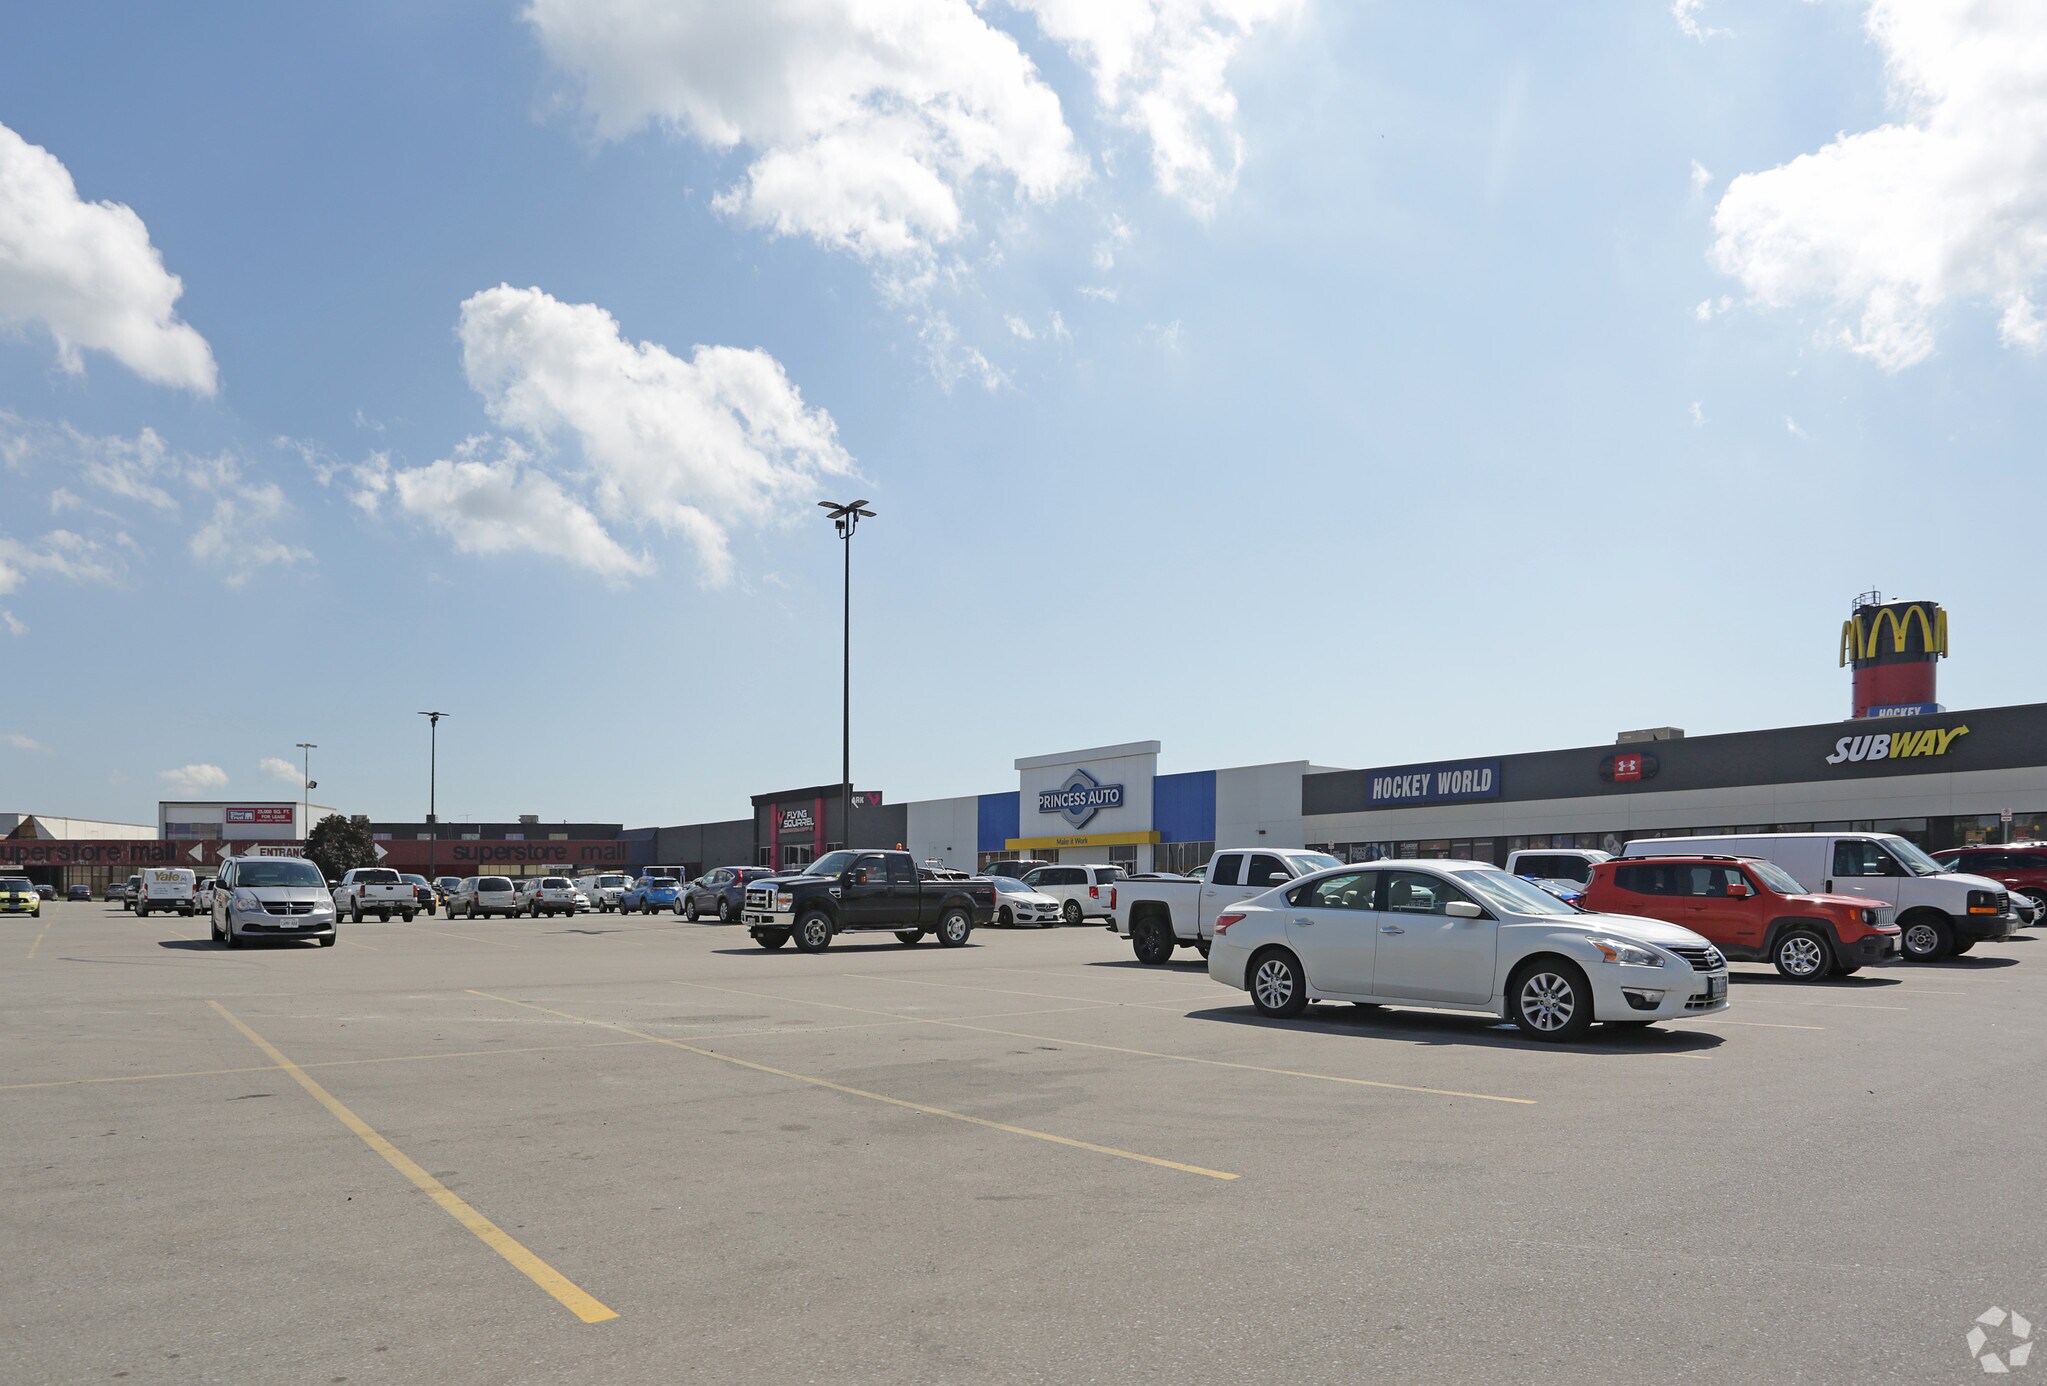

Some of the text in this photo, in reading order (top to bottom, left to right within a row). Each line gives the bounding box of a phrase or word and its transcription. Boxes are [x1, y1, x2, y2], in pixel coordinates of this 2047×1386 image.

[1879, 706, 1922, 717] HOCKEY
[1825, 724, 1970, 765] SUBWAY
[1373, 768, 1492, 799] HOCKEY WORLD
[1039, 789, 1119, 808] PRINCESS AUTO
[787, 809, 808, 819] FLYING
[783, 818, 814, 828] SQUIRREL
[0, 842, 176, 864] uperstore mall
[260, 847, 306, 857] ENTRANC
[453, 841, 626, 864] superstore mall
[154, 871, 180, 881] Yale
